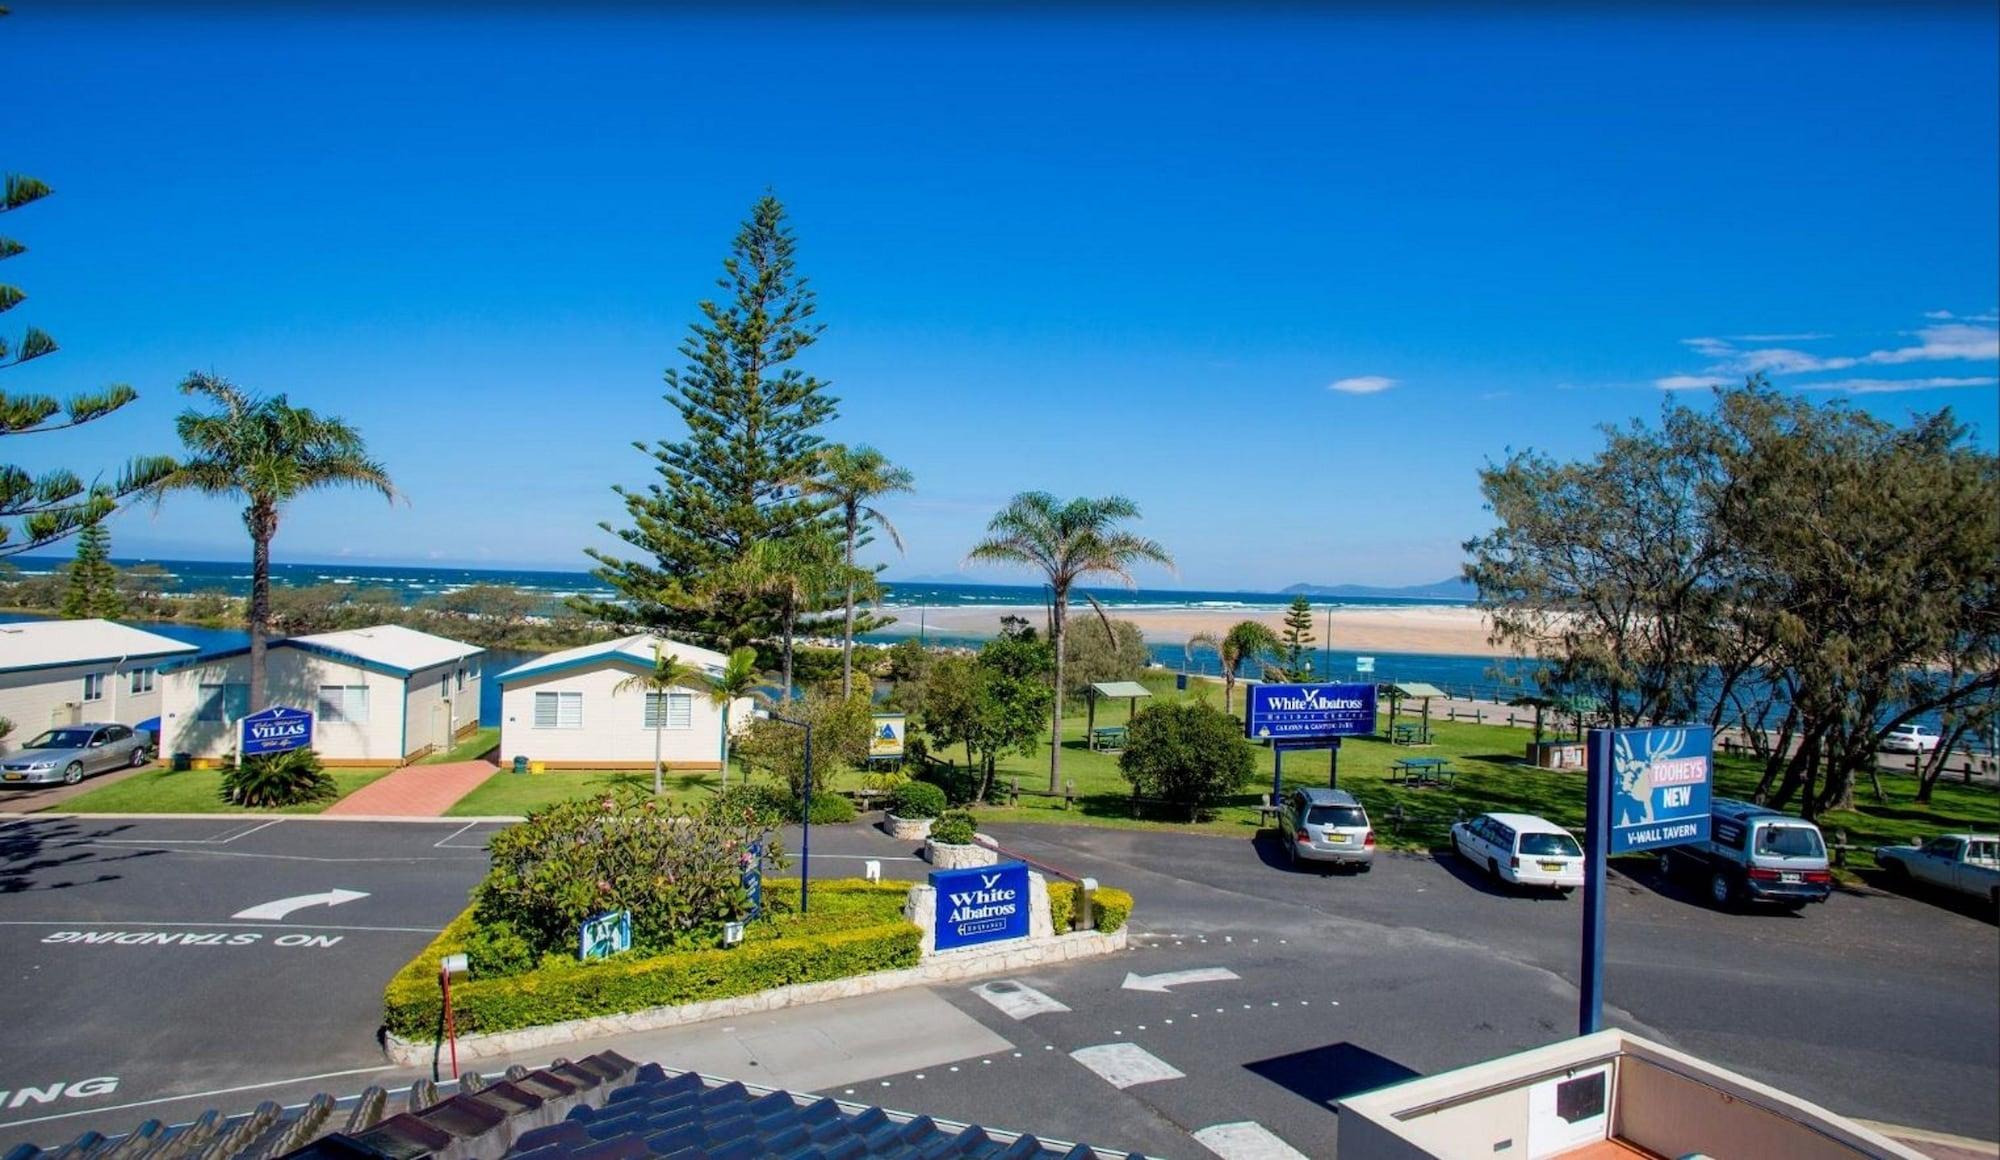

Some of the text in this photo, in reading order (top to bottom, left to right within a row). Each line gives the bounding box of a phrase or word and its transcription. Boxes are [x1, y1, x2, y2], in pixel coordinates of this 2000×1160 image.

[1268, 696, 1363, 710] White Albatross
[252, 724, 305, 738] VILLAS
[1654, 761, 1703, 781] TOOHEYS
[1663, 786, 1691, 808] NEW
[1627, 824, 1697, 845] V-WALL TAVERN
[949, 889, 1016, 907] White
[948, 904, 1016, 923] Albatross
[40, 931, 344, 948] NO STANDING
